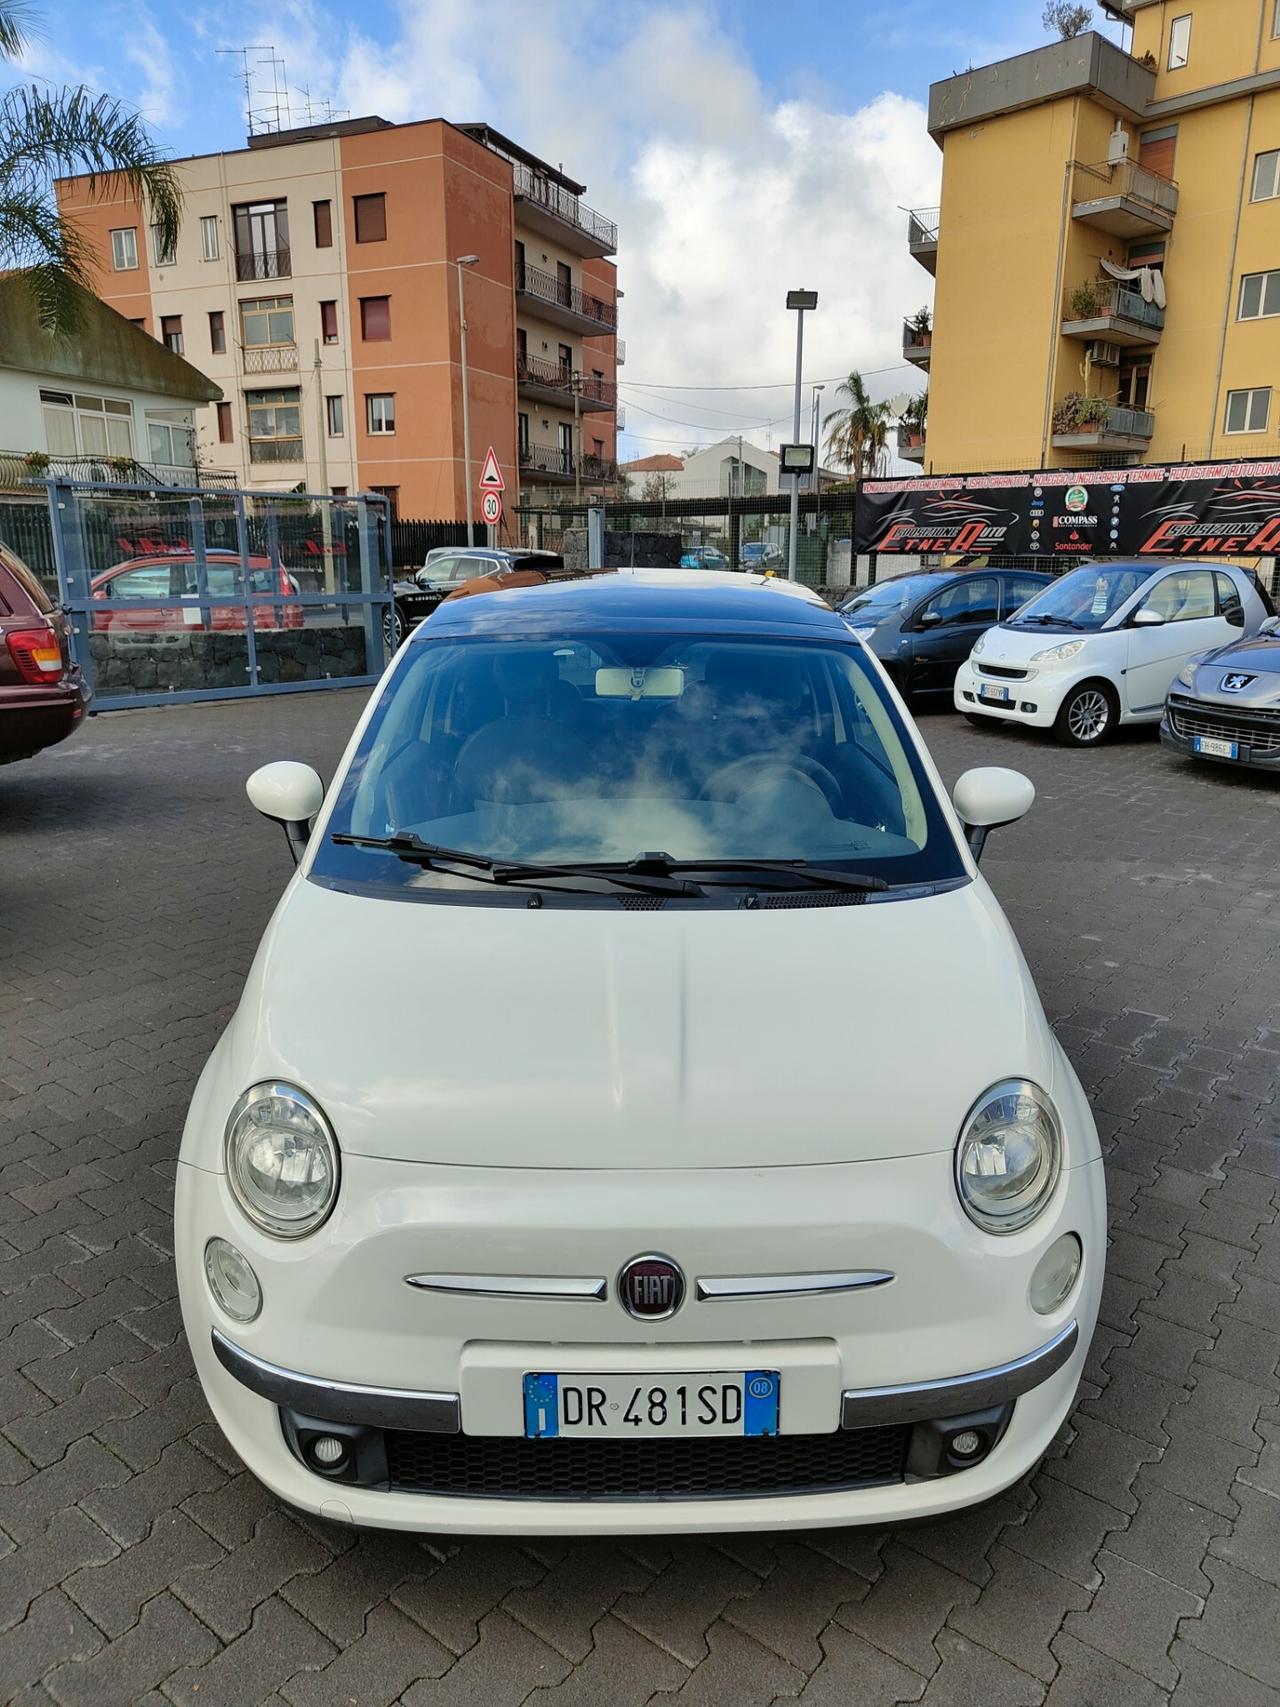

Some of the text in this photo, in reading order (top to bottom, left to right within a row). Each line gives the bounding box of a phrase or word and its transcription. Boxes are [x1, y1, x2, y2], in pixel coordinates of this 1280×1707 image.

[1101, 470, 1127, 484] BREVE
[1128, 469, 1165, 483] TERMINE
[1228, 464, 1256, 477] AUTO
[1254, 463, 1275, 476] CON
[486, 499, 497, 515] 30
[1059, 516, 1098, 525] COMPASS
[1055, 542, 1092, 551] Santander
[634, 1275, 671, 1304] FIAT
[562, 1387, 607, 1426] DR
[753, 1382, 768, 1393] 08
